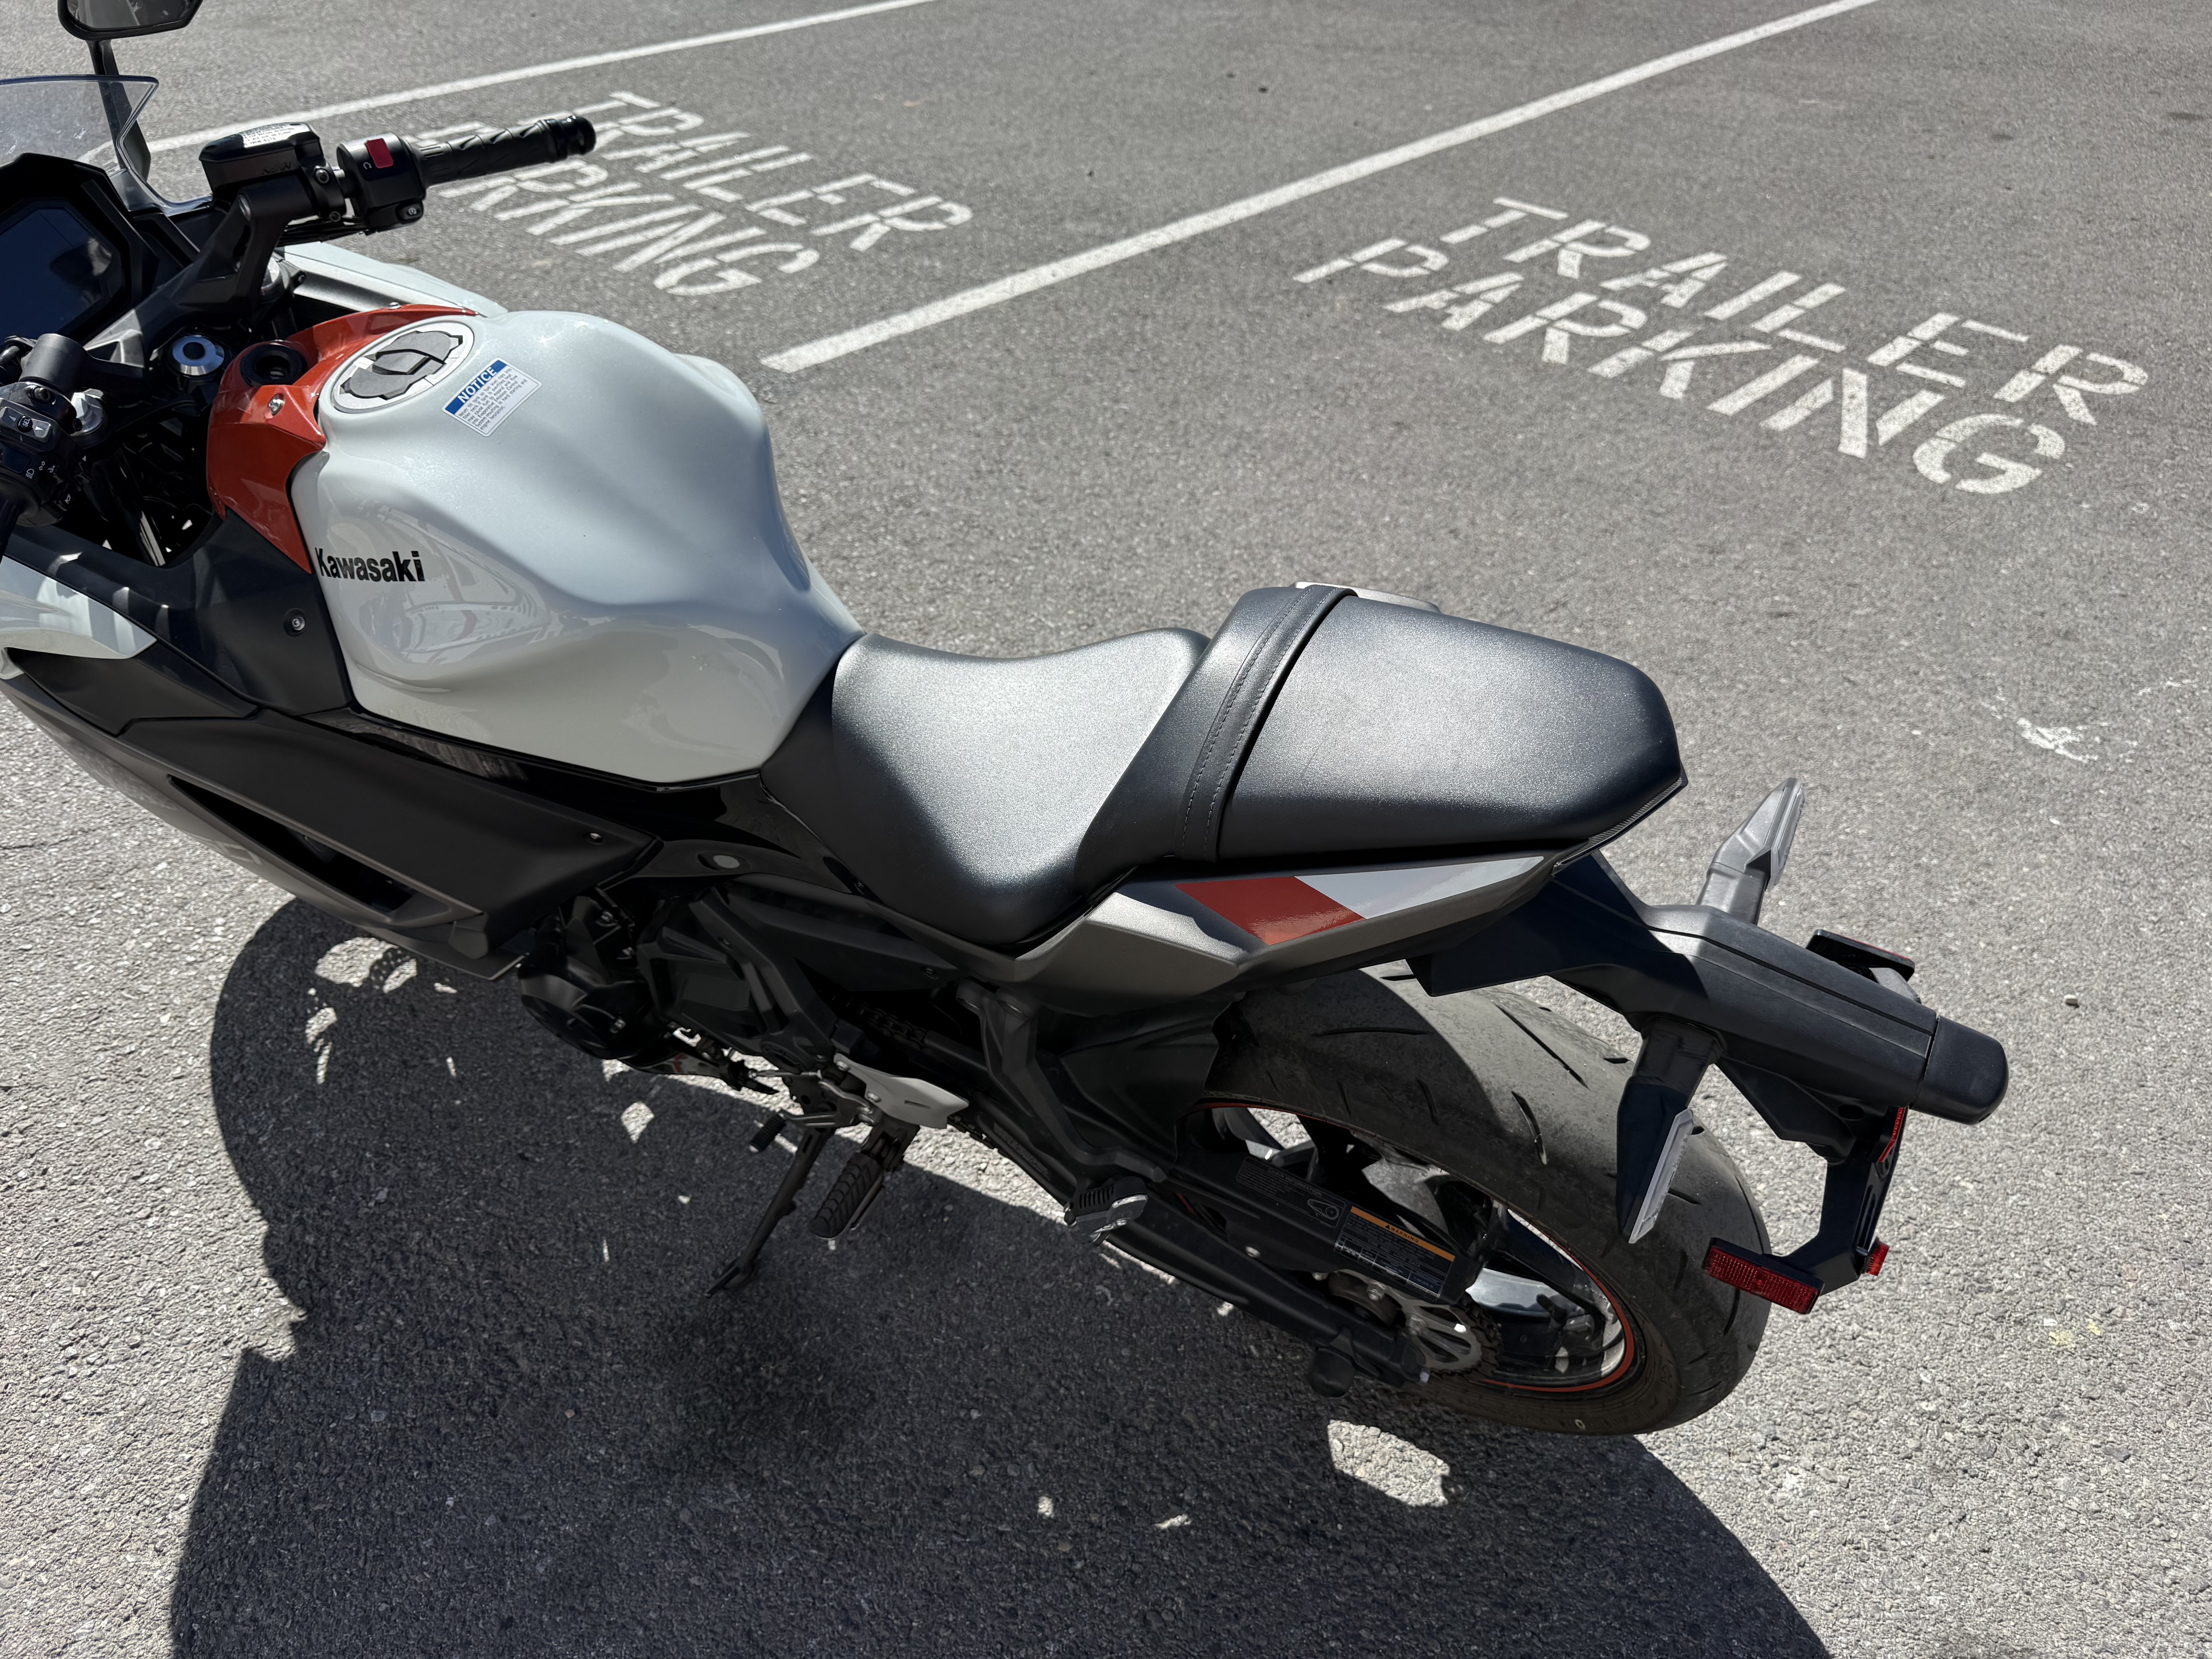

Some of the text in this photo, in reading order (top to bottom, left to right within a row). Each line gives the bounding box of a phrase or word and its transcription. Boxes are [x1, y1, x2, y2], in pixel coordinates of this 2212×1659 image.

[517, 90, 973, 251] TRAILER
[405, 121, 820, 296] RKING
[1440, 196, 2148, 425] TRAILER
[1293, 238, 2064, 495] PARKING
[457, 366, 498, 404] NOTICE
[22, 417, 31, 427] SEL
[474, 406, 483, 415] cause
[479, 420, 491, 430] engine
[315, 547, 425, 582] Kawasaki
[1391, 1227, 1419, 1243] WARNING
